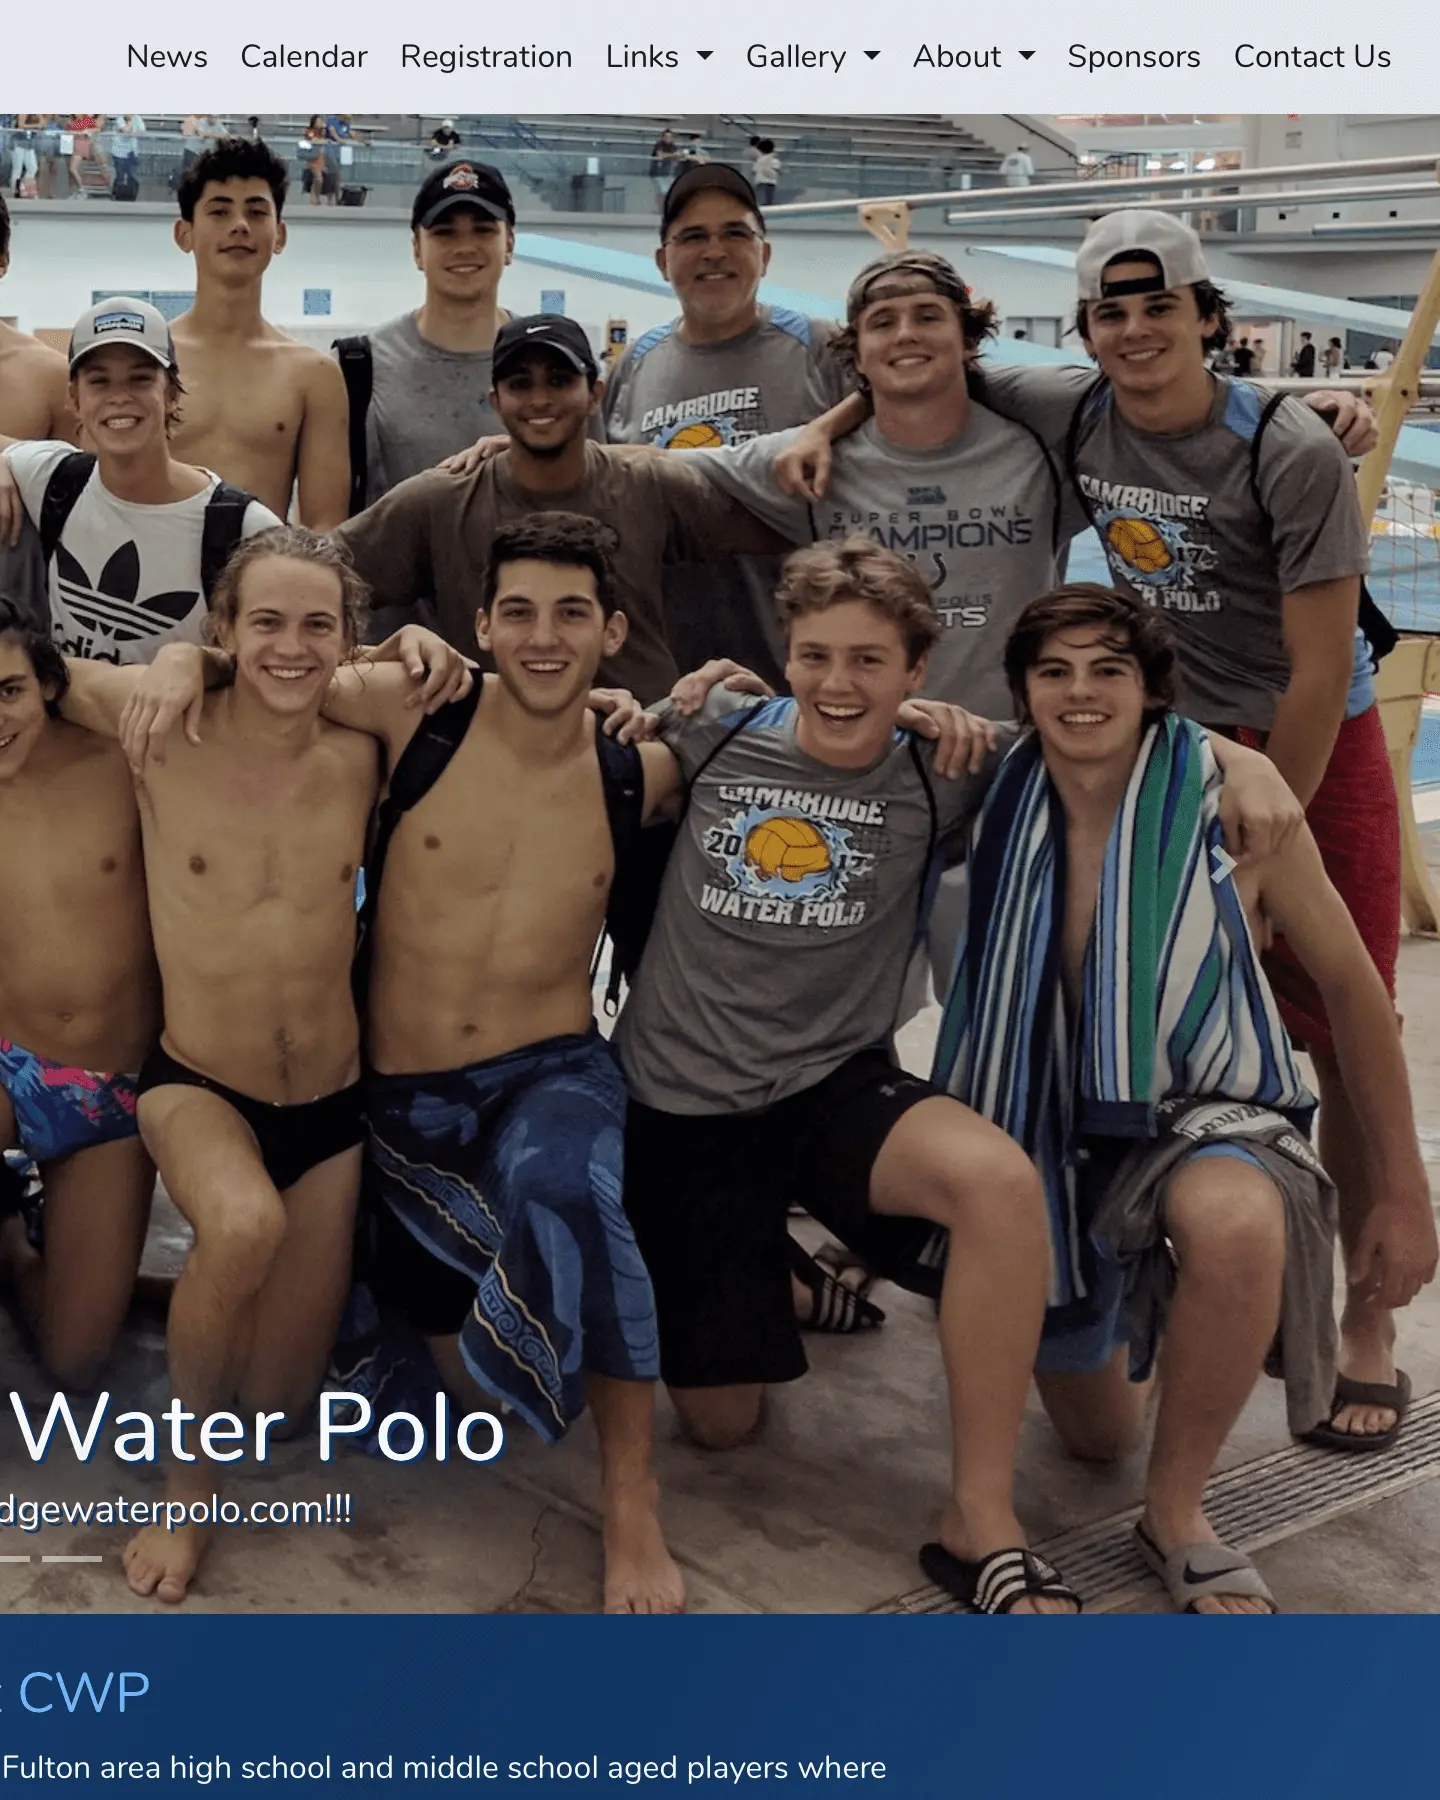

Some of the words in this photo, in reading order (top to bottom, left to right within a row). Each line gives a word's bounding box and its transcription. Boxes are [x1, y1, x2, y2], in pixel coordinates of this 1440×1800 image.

[641, 387, 759, 432] CAMBRIDGE
[1079, 474, 1209, 520] CAMBRIDGE
[833, 511, 920, 524] SUPER
[948, 505, 1025, 521] BOWL
[937, 594, 993, 606] POLIS
[1161, 586, 1221, 612] POLO
[707, 830, 742, 856] 20
[839, 854, 868, 870] 17
[700, 884, 795, 925] WATER
[799, 900, 867, 928] POLO
